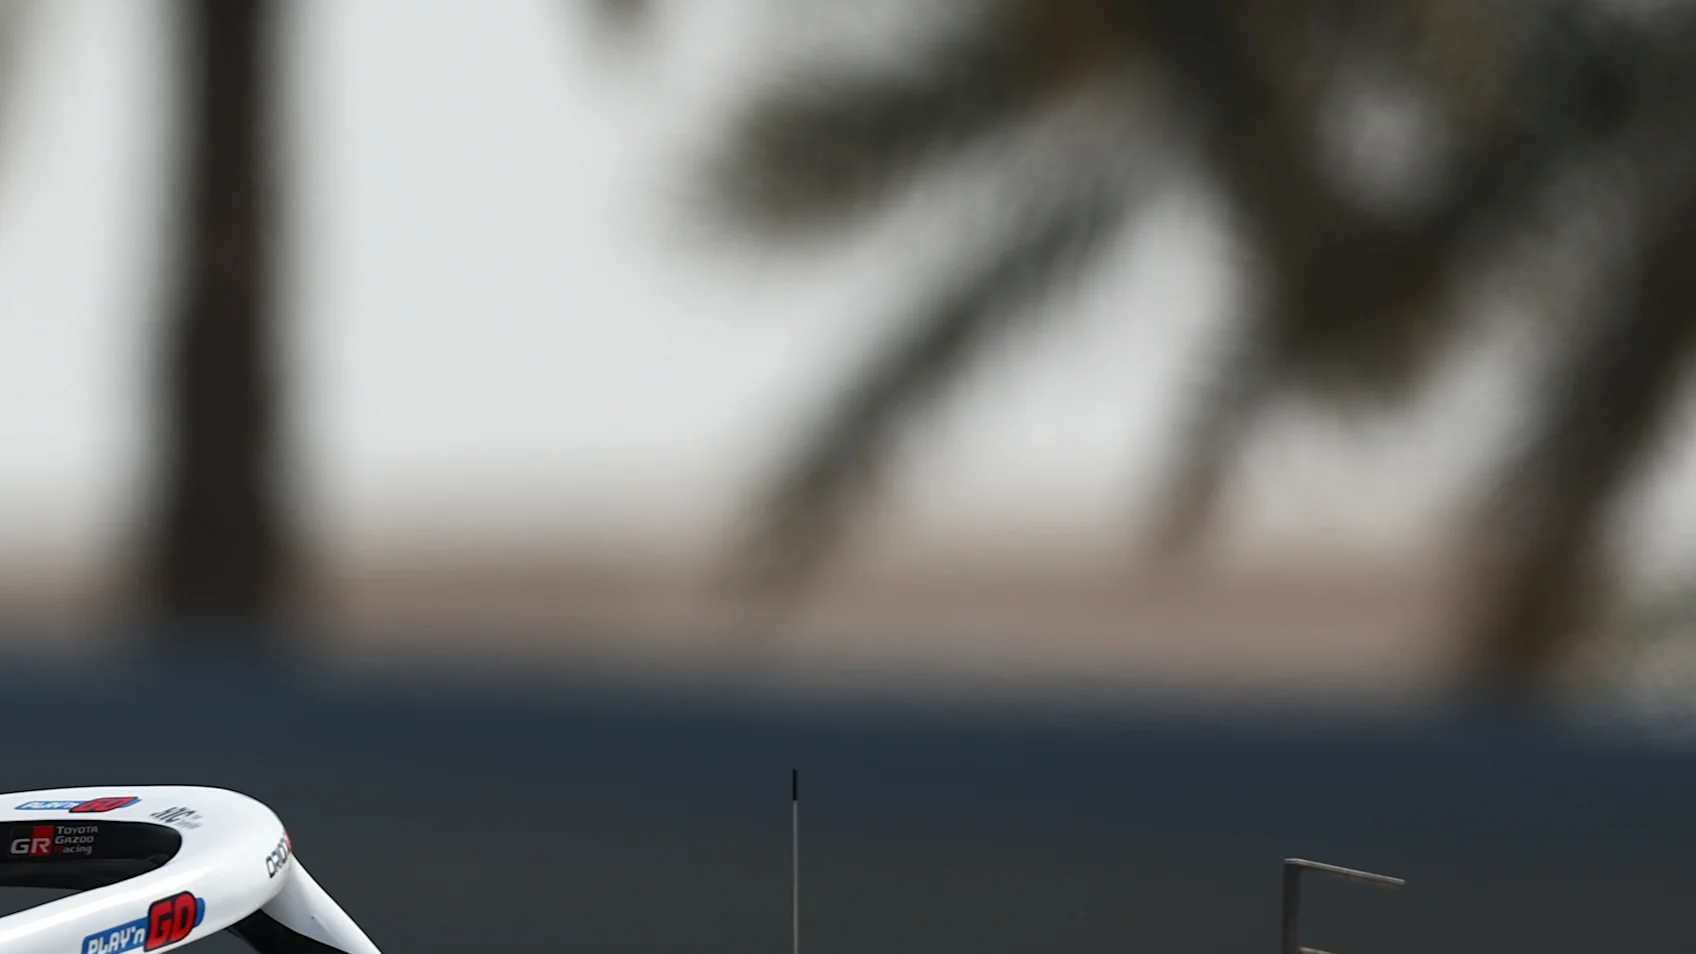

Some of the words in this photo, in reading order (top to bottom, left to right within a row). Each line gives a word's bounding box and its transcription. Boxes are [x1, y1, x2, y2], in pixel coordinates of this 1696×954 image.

[56, 825, 99, 835] TOYOTA
[10, 838, 51, 855] GR
[145, 889, 198, 953] GO
